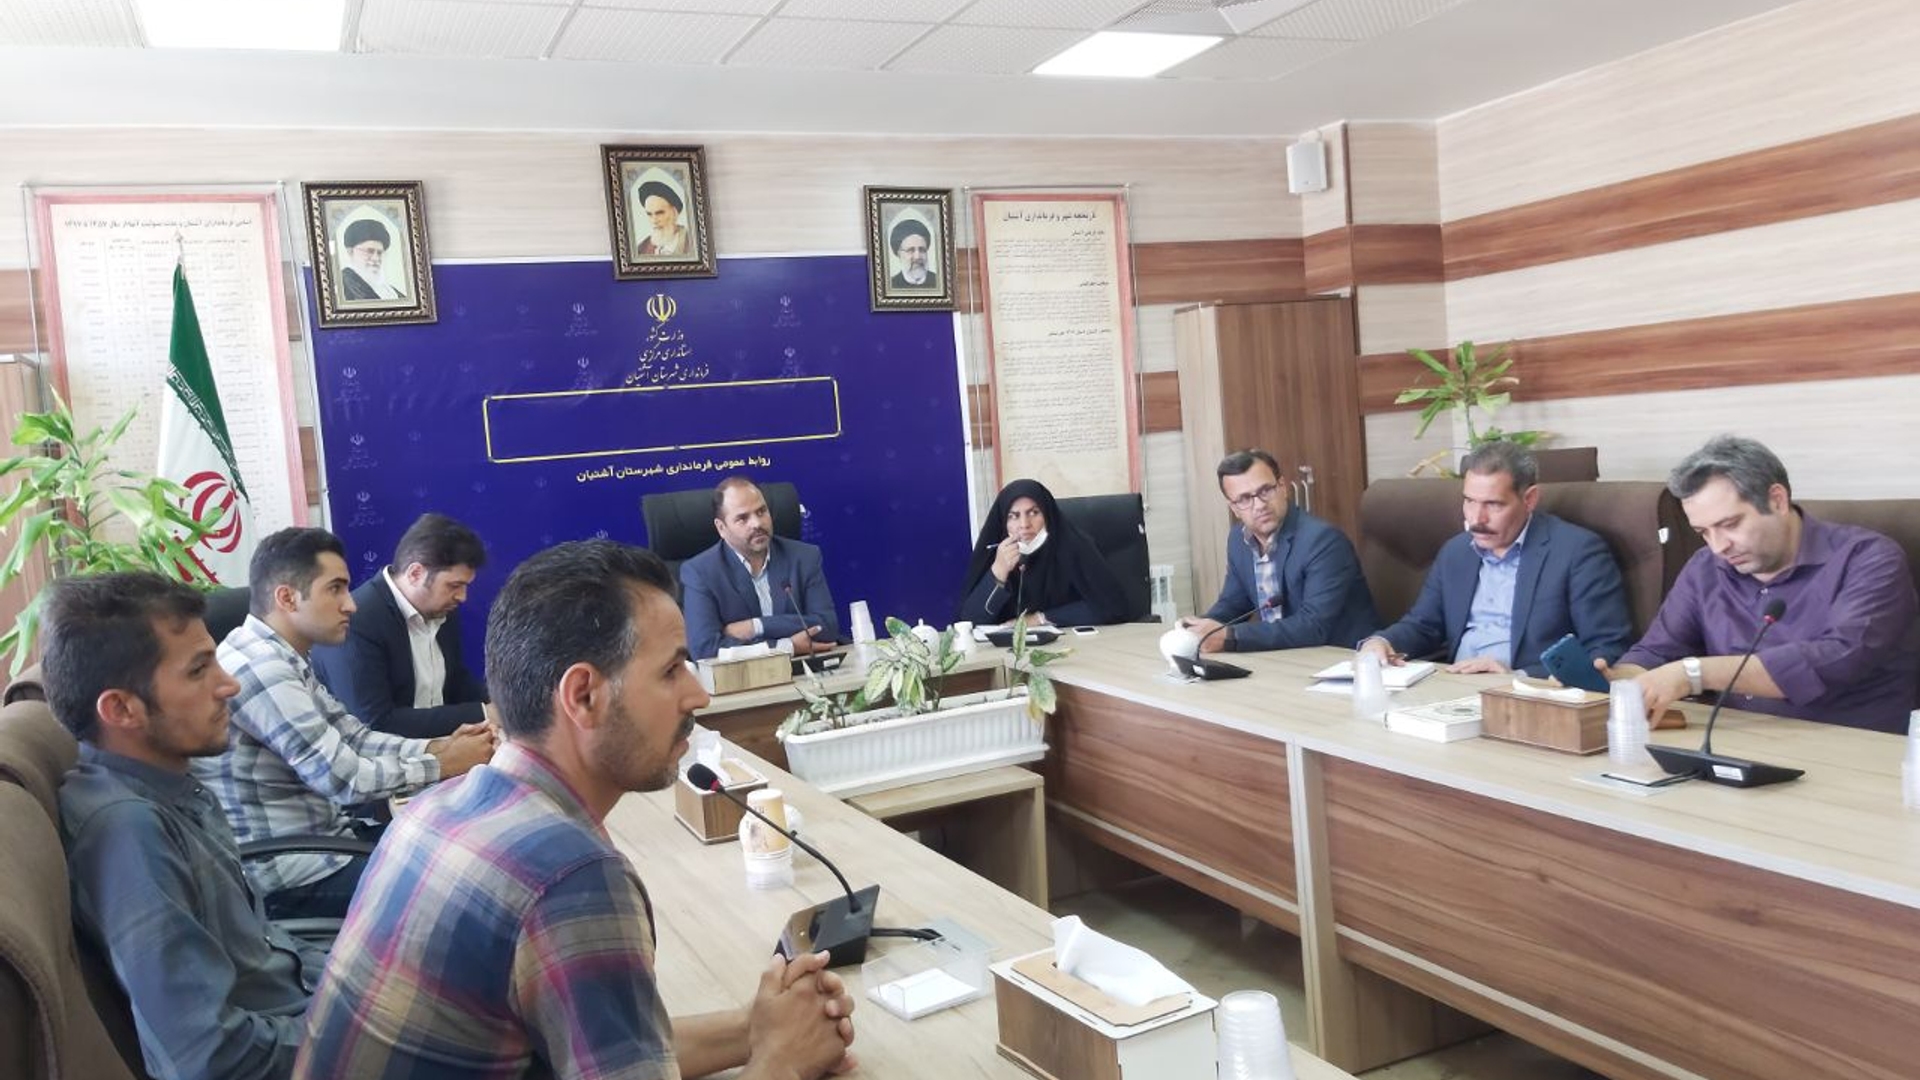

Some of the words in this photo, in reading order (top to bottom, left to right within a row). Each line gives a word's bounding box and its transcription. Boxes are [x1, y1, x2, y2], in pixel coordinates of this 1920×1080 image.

[659, 329, 685, 341] وزارت
[638, 341, 662, 362] مرکزی
[651, 362, 680, 383] شهرستان
[678, 362, 710, 381] فرمانداری
[666, 459, 713, 475] فرمانداری
[714, 459, 746, 471] عمومی
[748, 455, 771, 467] روابط
[576, 465, 613, 483] آشتیان
[616, 463, 664, 480] شهرستان
